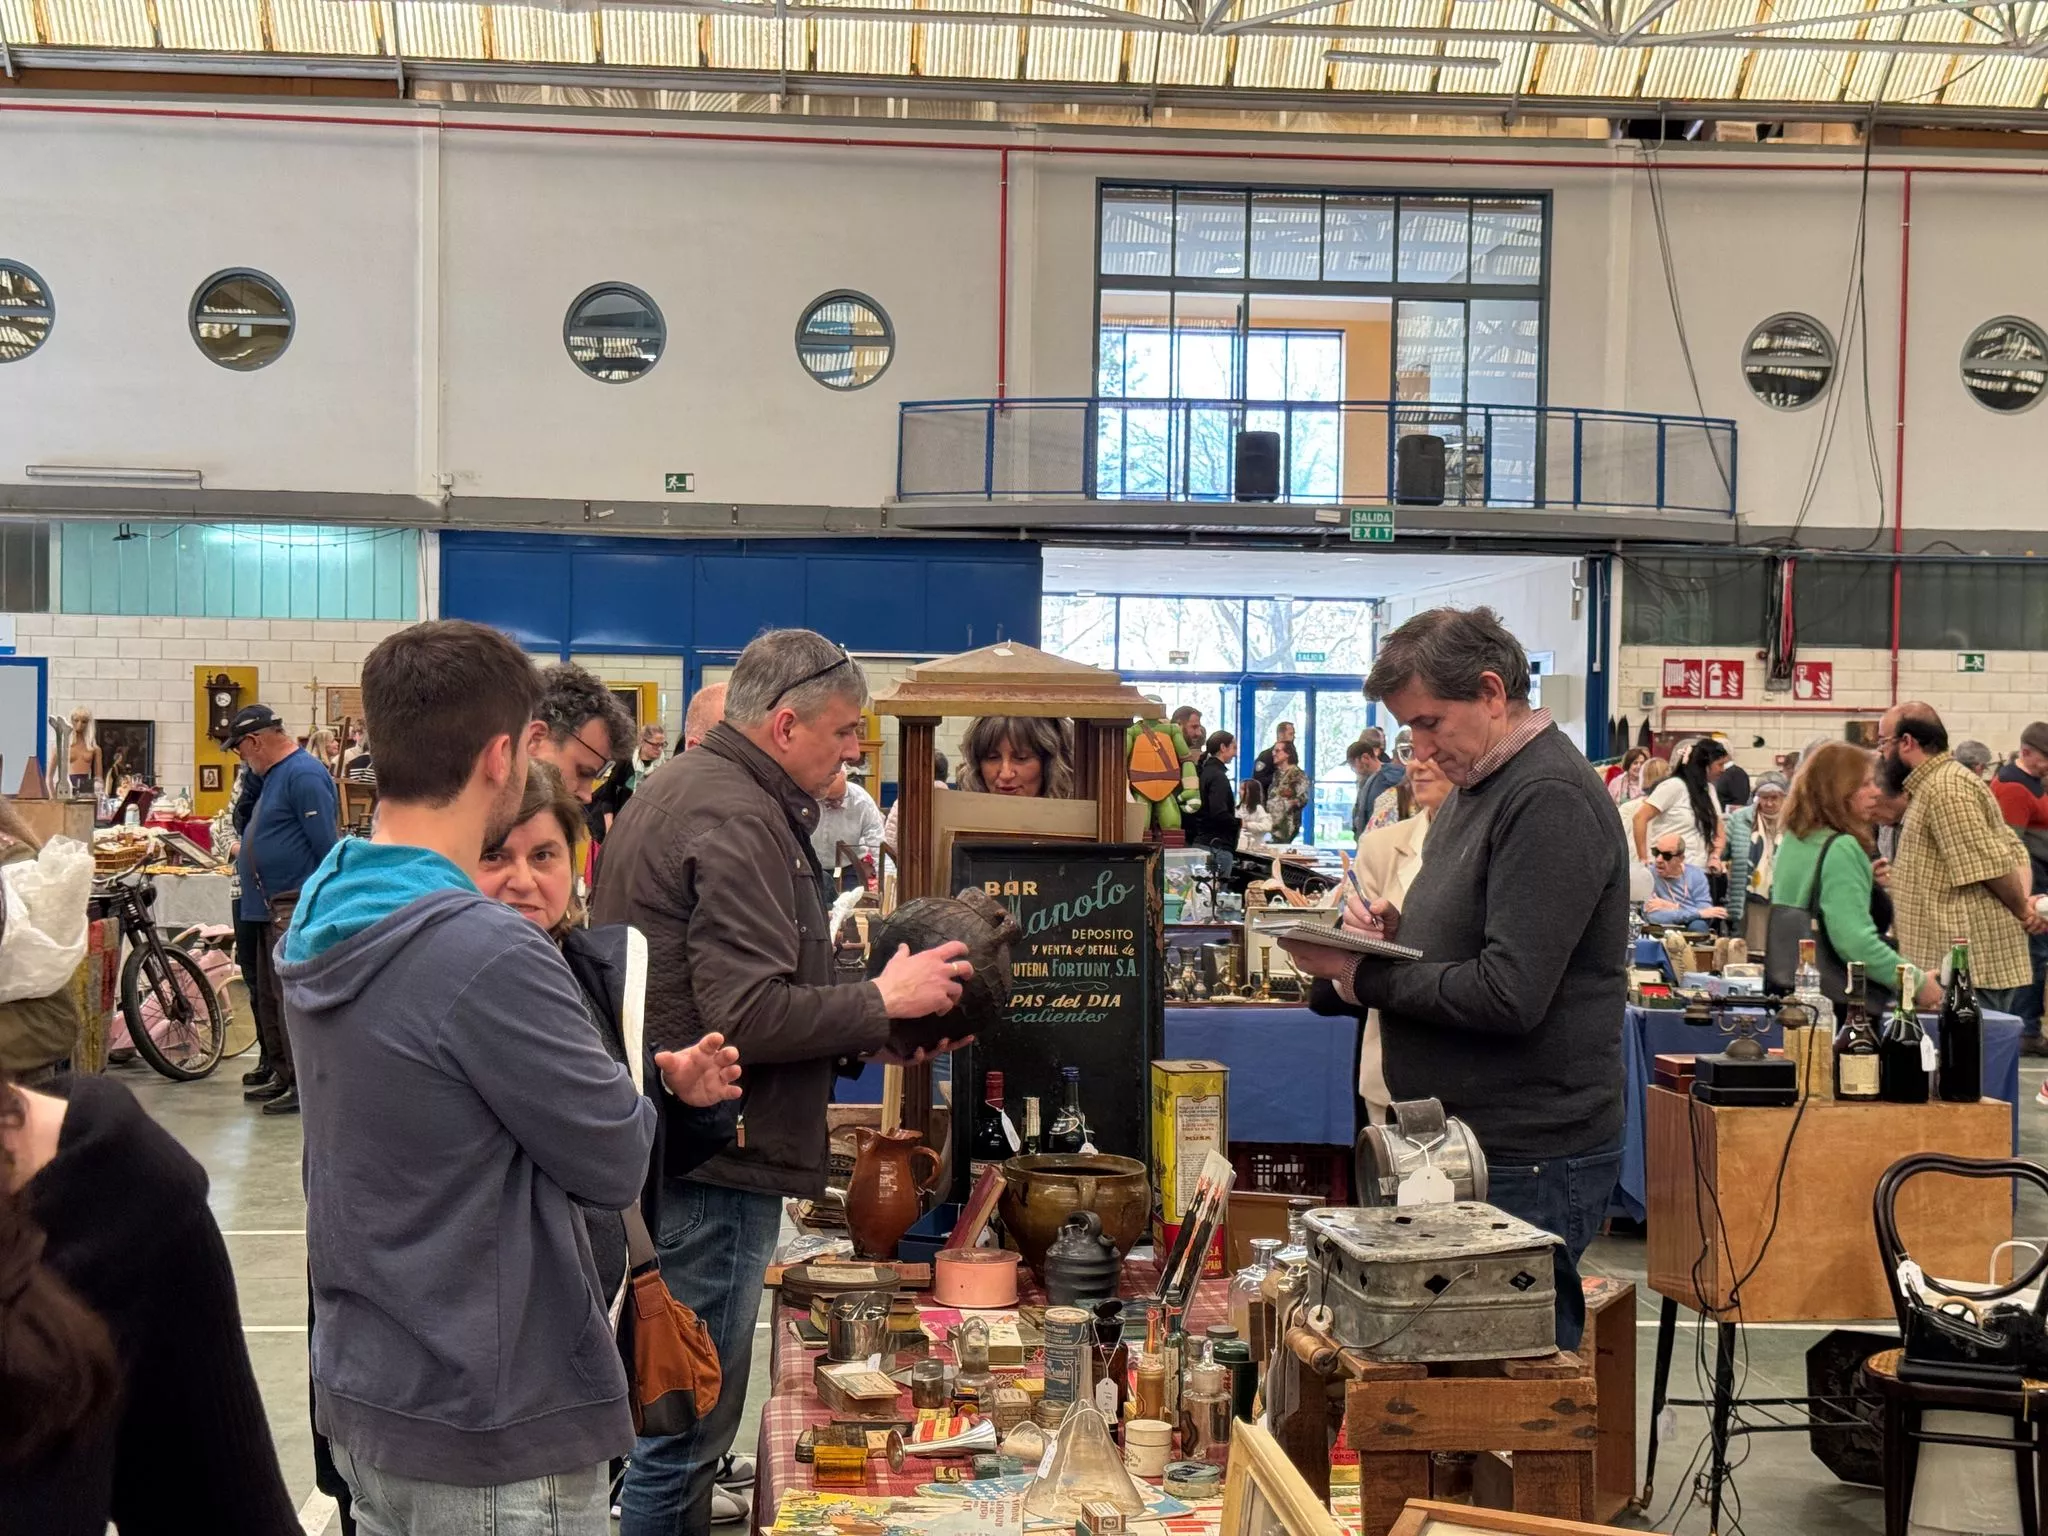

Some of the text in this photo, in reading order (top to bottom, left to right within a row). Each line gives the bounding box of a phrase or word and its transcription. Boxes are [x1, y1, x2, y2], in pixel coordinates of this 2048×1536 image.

[1354, 512, 1391, 523] SALIDA
[1353, 527, 1391, 538] EXIT
[984, 880, 1039, 896] BAR
[1071, 928, 1134, 940] DEPOSITO
[1042, 944, 1073, 955] VENTA
[1087, 944, 1119, 956] DETALL
[1121, 943, 1136, 957] de
[1011, 962, 1050, 978] UTERIA
[1115, 958, 1140, 978] S.A.
[1005, 993, 1121, 1009] PAS del DIA
[1002, 1007, 1109, 1023] calientes
